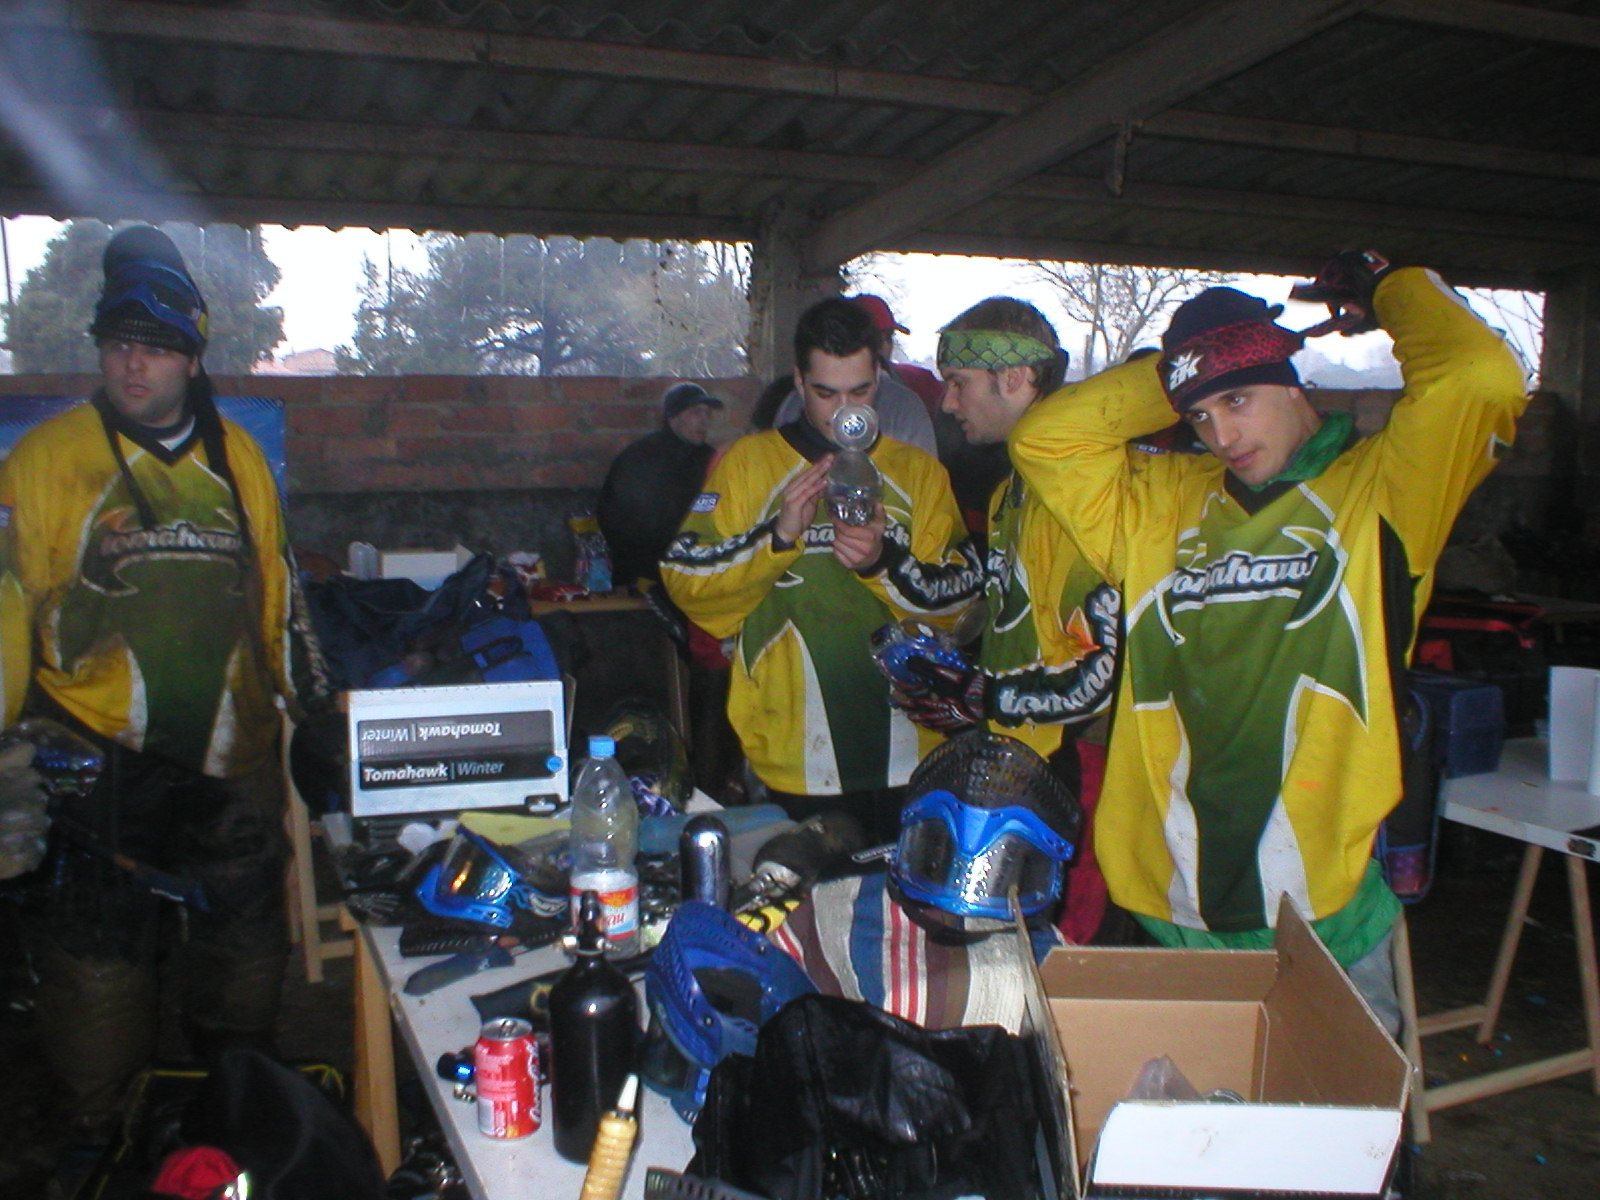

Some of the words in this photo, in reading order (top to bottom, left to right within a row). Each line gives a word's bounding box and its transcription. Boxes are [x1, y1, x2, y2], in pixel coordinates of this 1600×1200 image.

[361, 728, 409, 742] Winter
[419, 722, 502, 741] Tomahawk
[364, 762, 449, 782] Tomahawk
[457, 761, 505, 776] Winter
